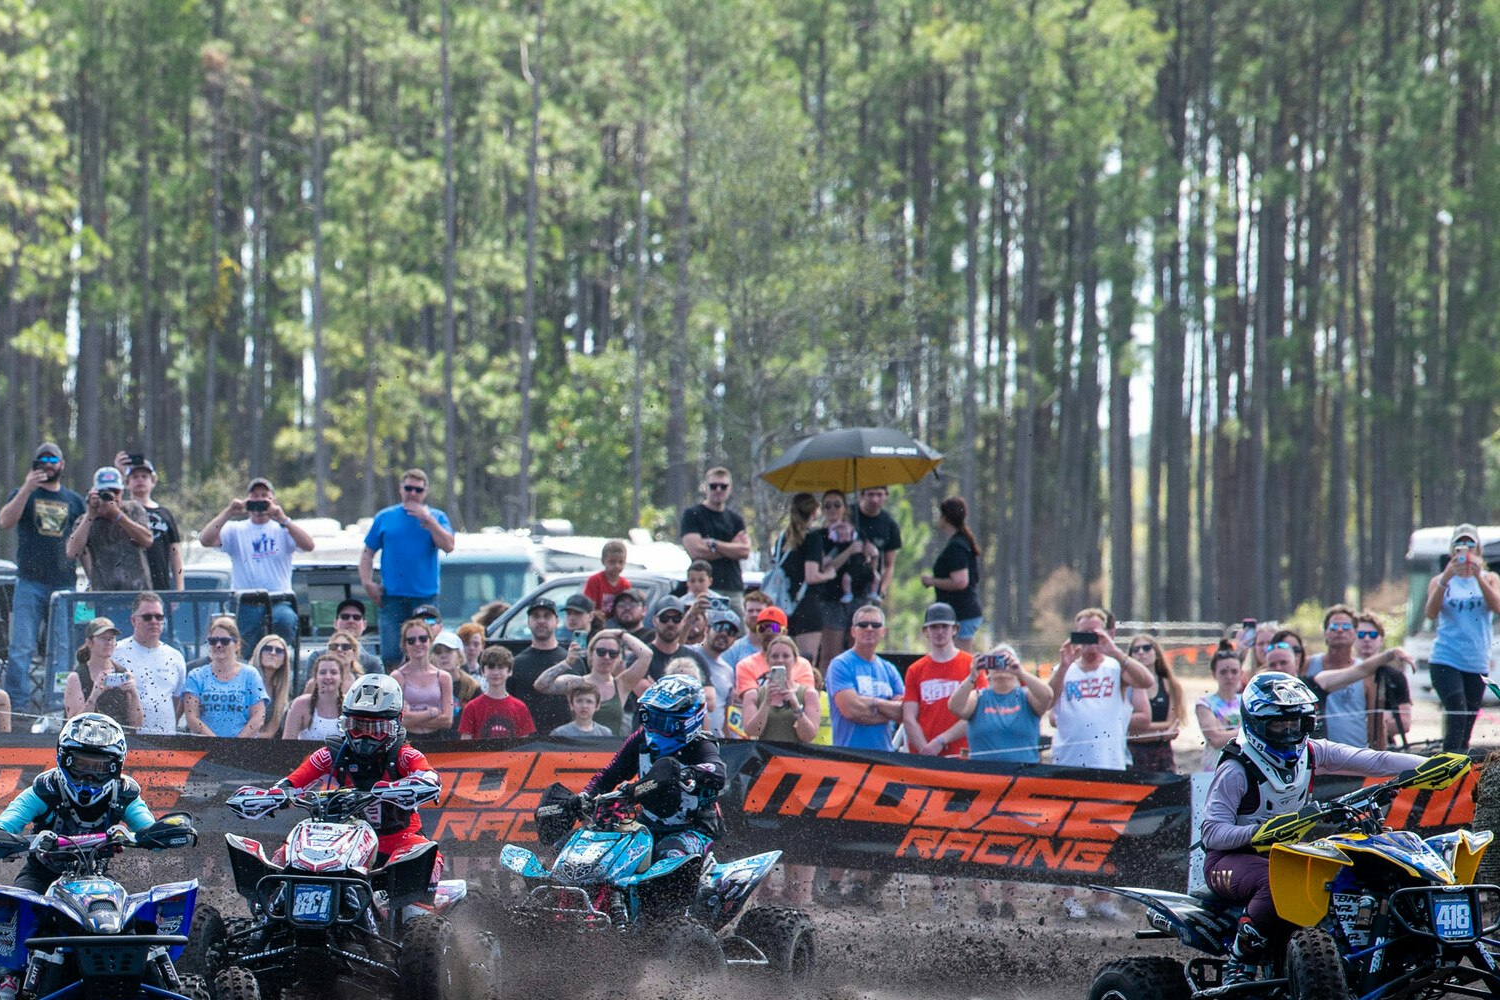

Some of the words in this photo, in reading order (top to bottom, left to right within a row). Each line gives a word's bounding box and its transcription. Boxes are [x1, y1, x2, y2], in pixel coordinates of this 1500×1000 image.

[743, 755, 1158, 841] MOOSE
[431, 811, 542, 842] RAC
[895, 826, 1119, 874] RACING
[1436, 904, 1470, 930] 418
